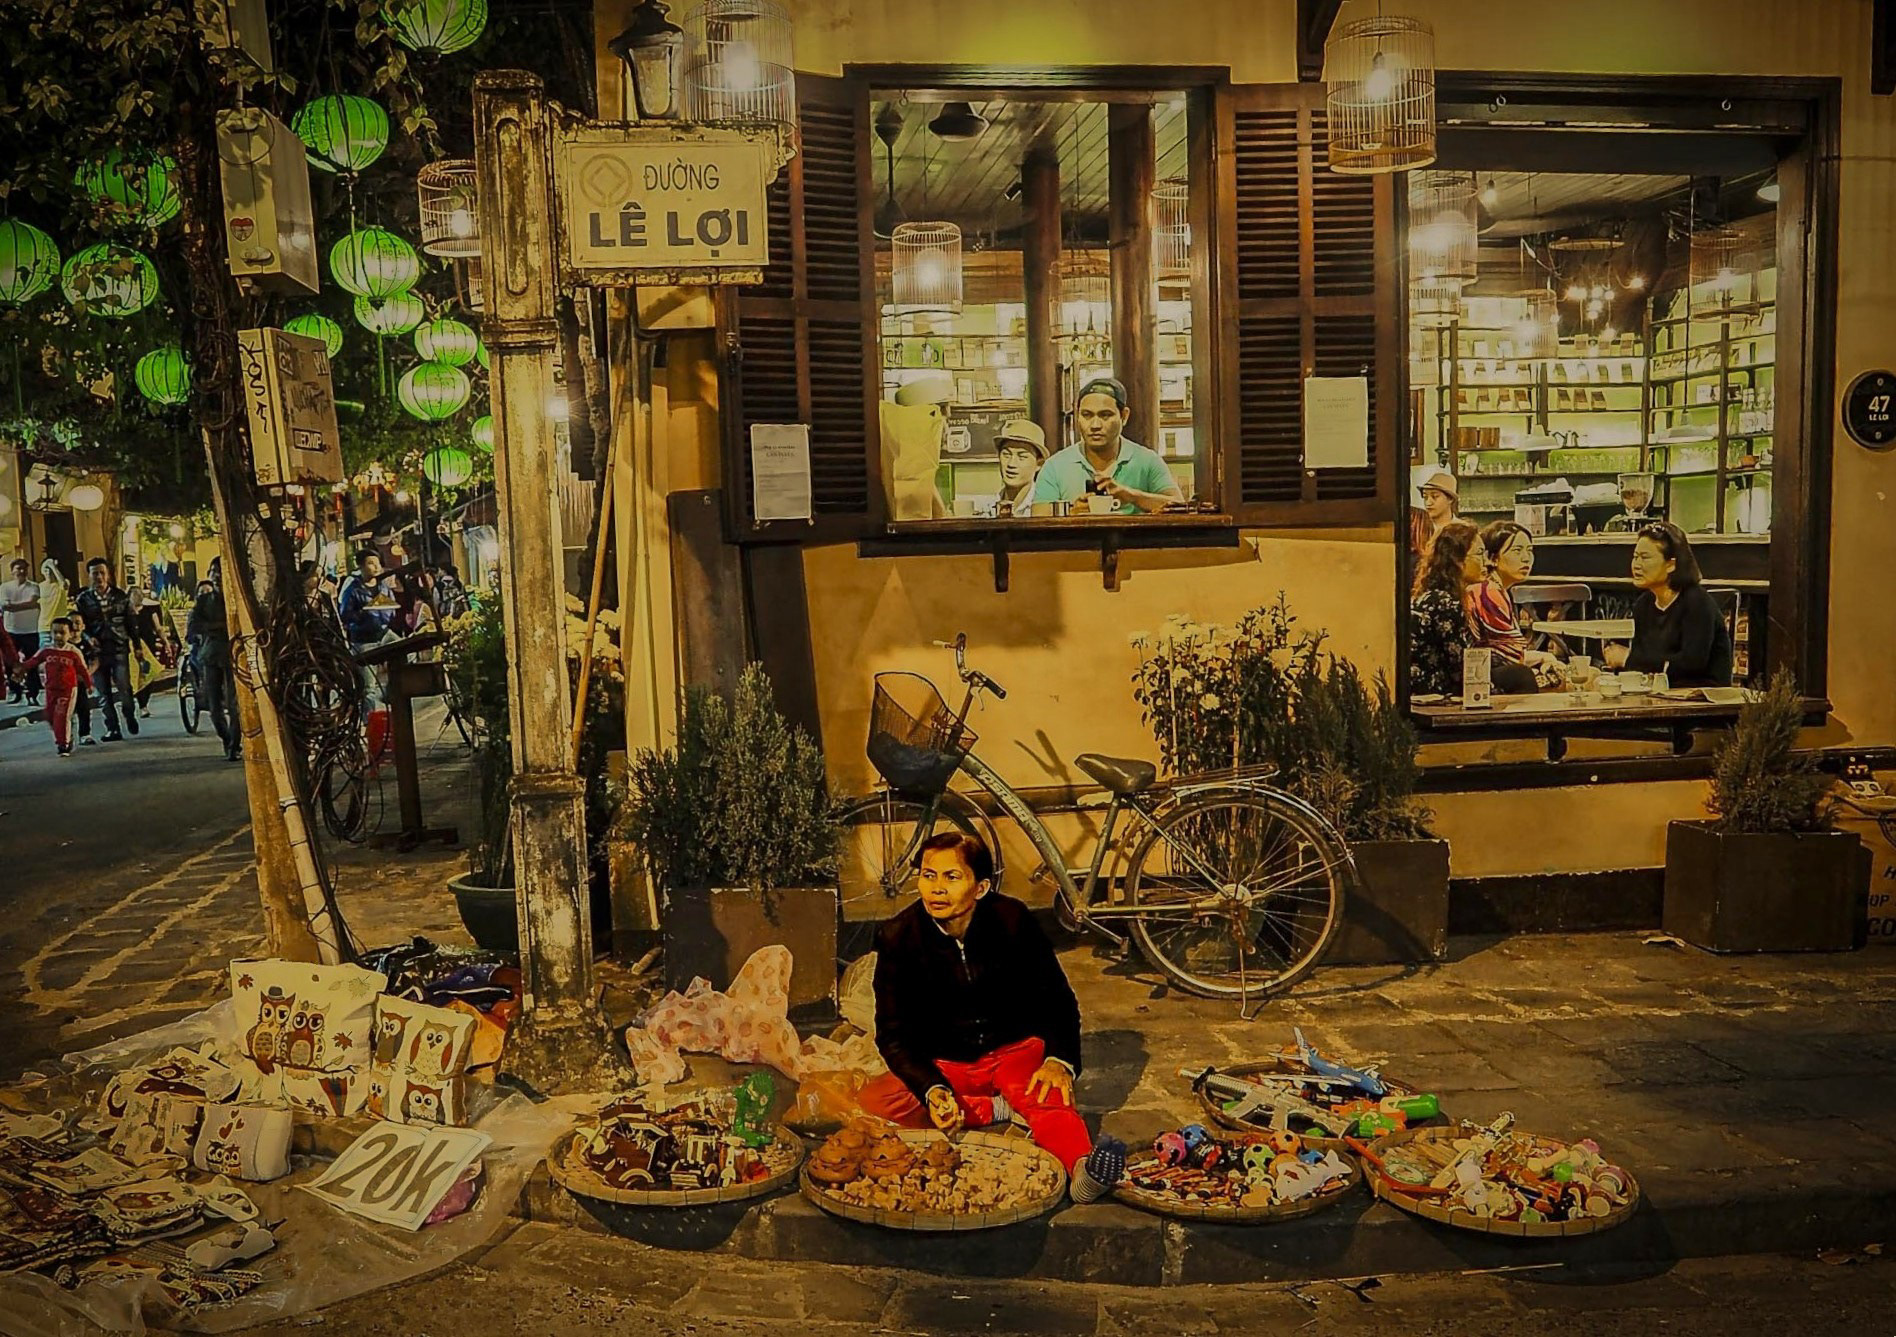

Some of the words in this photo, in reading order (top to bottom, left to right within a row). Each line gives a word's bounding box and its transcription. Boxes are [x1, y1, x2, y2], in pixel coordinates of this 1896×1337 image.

[643, 157, 720, 191] ĐƯỜNG
[589, 202, 647, 248] LÊ
[667, 208, 749, 258] LỢI
[1868, 395, 1890, 412] 47
